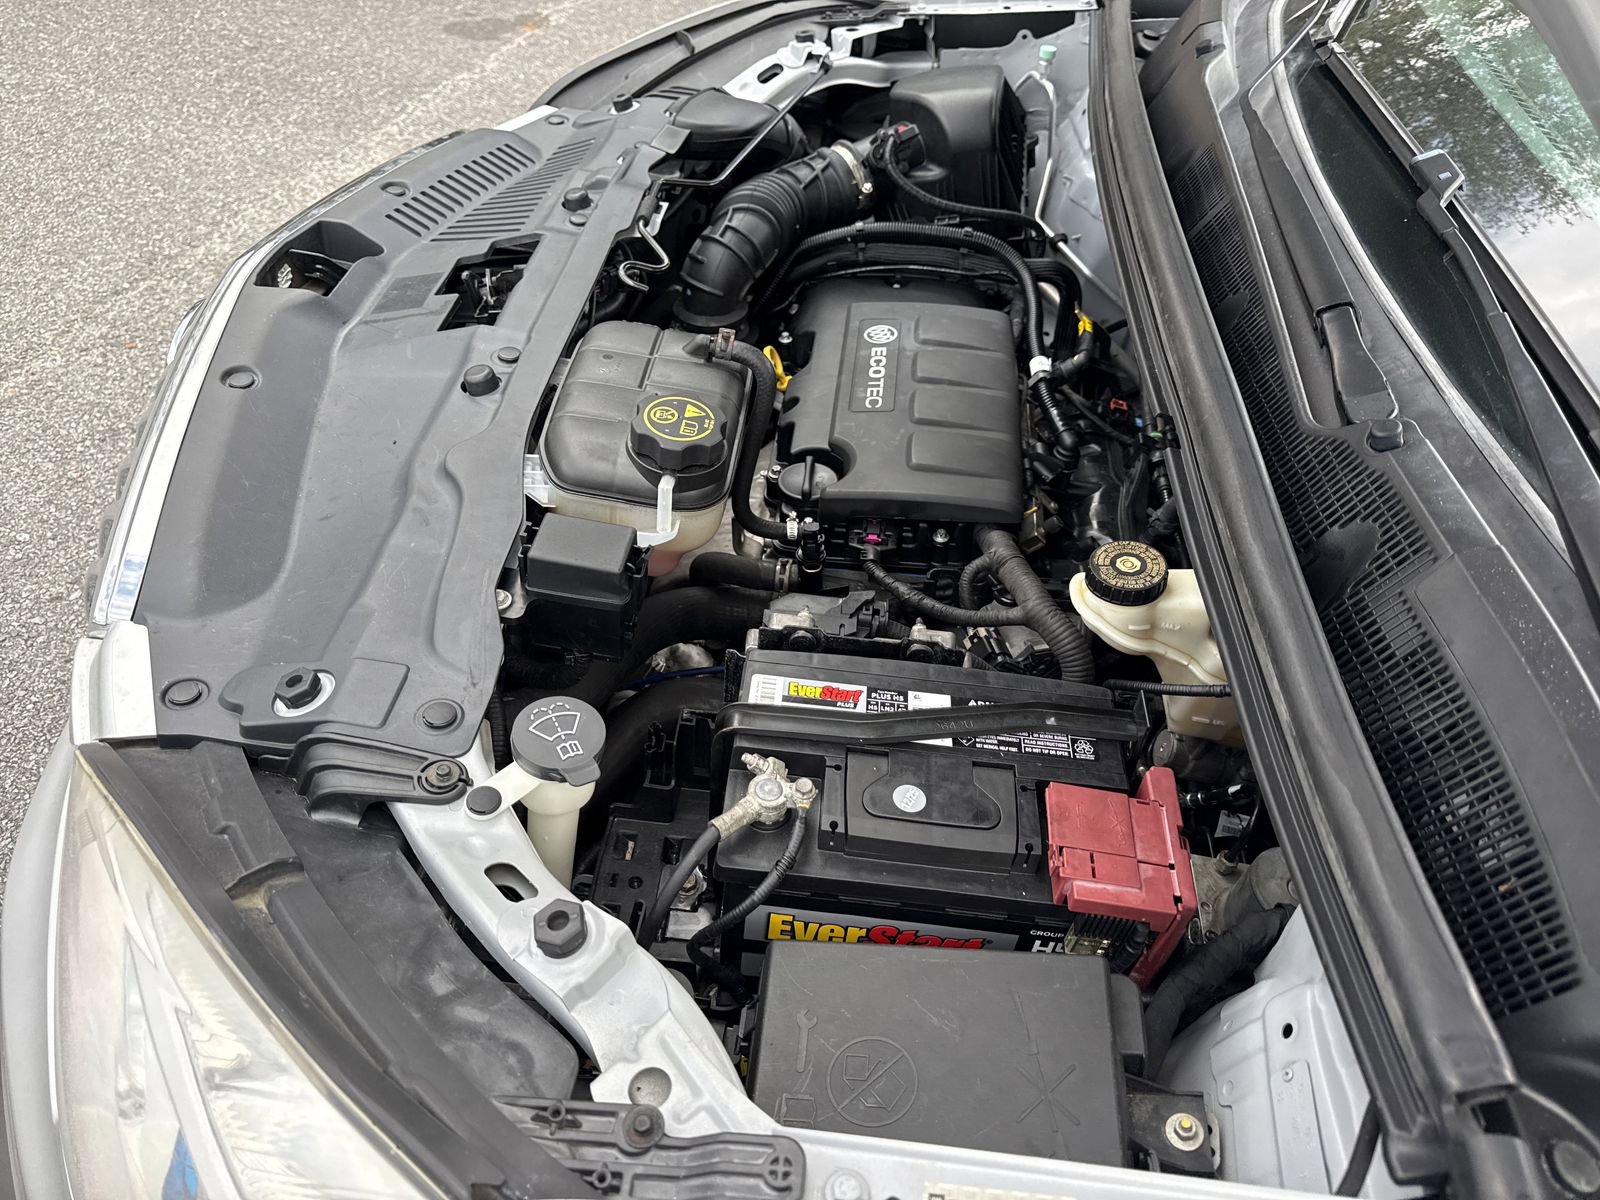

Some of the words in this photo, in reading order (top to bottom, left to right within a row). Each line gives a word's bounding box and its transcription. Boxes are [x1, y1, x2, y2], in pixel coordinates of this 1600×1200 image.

[865, 347, 887, 408] ECOTEC
[788, 681, 863, 702] EverStart
[871, 692, 891, 700] PLUS
[1030, 929, 1064, 938] GROUP
